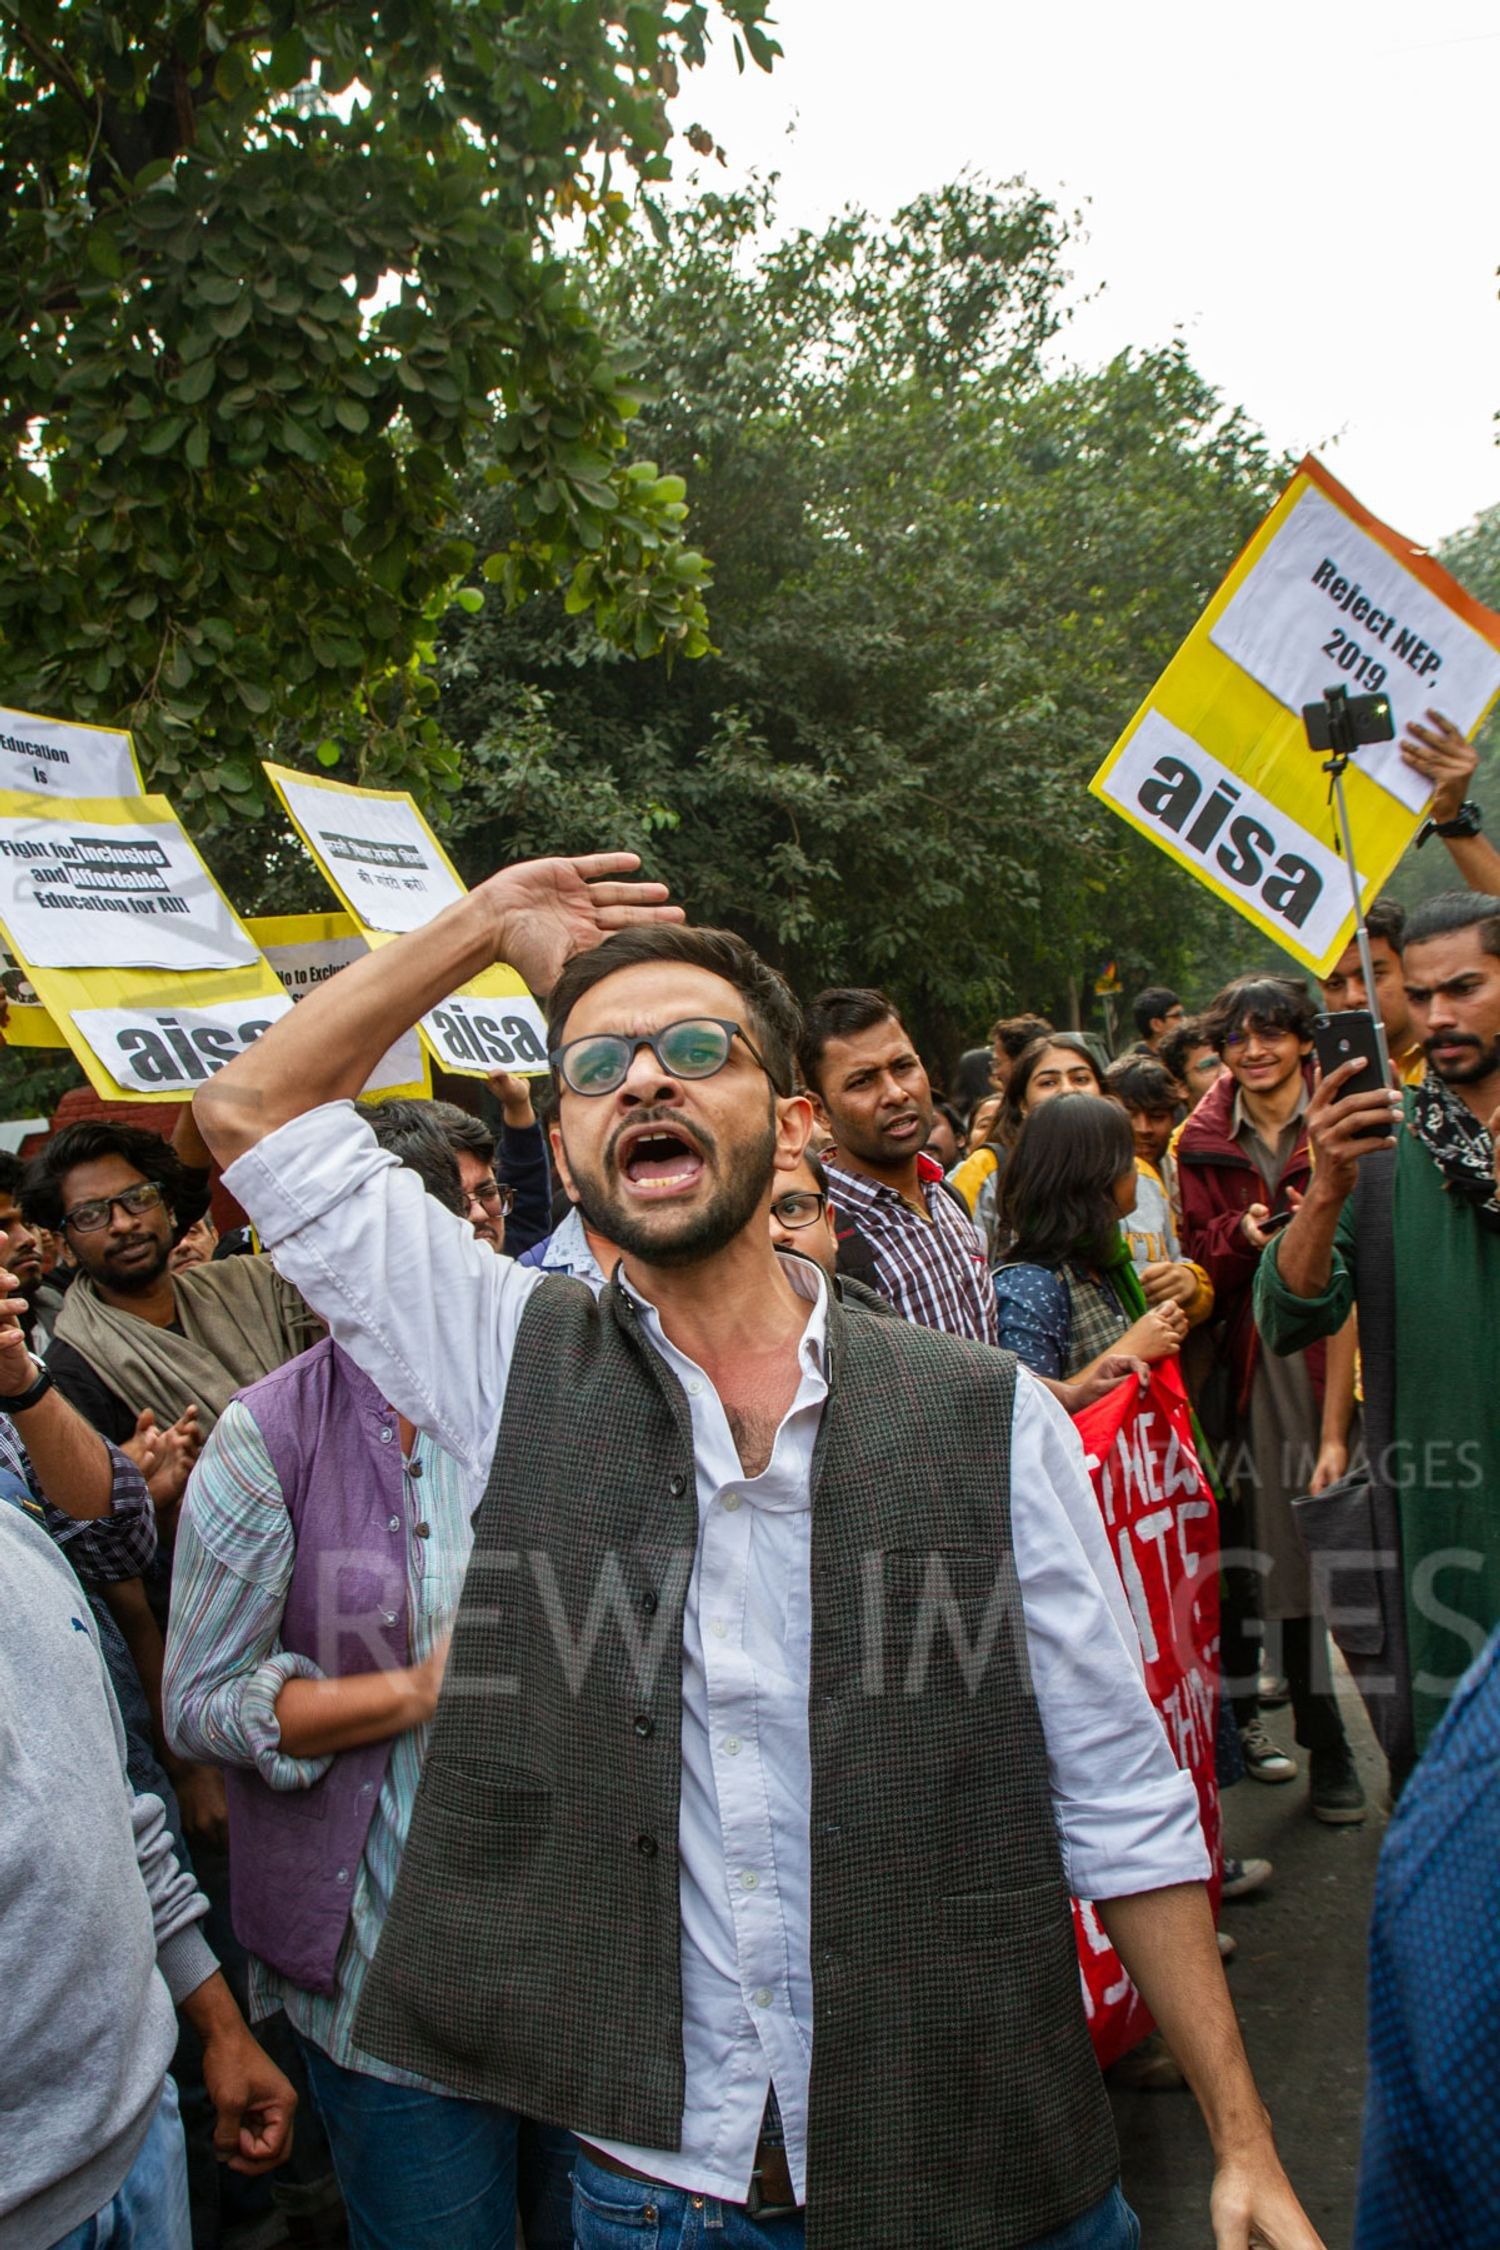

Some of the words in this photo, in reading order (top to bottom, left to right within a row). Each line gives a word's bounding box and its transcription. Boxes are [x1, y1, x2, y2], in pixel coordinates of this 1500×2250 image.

[1311, 557, 1397, 643] Reject
[1390, 626, 1442, 688] NEP,
[1321, 627, 1388, 692] 2019
[0, 734, 70, 764] Education
[33, 766, 48, 784] Is
[0, 840, 47, 858] Fight
[49, 842, 78, 859] for
[77, 844, 165, 864] Inclusive
[1137, 756, 1323, 930] aisa
[31, 867, 69, 883] and
[69, 867, 165, 888] Affordable
[34, 891, 129, 913] Education
[127, 897, 157, 914] for
[157, 897, 190, 913] All!
[294, 970, 307, 984] to
[309, 961, 350, 982] Exclu
[432, 1004, 548, 1064] aisa
[116, 1017, 274, 1082] ais
